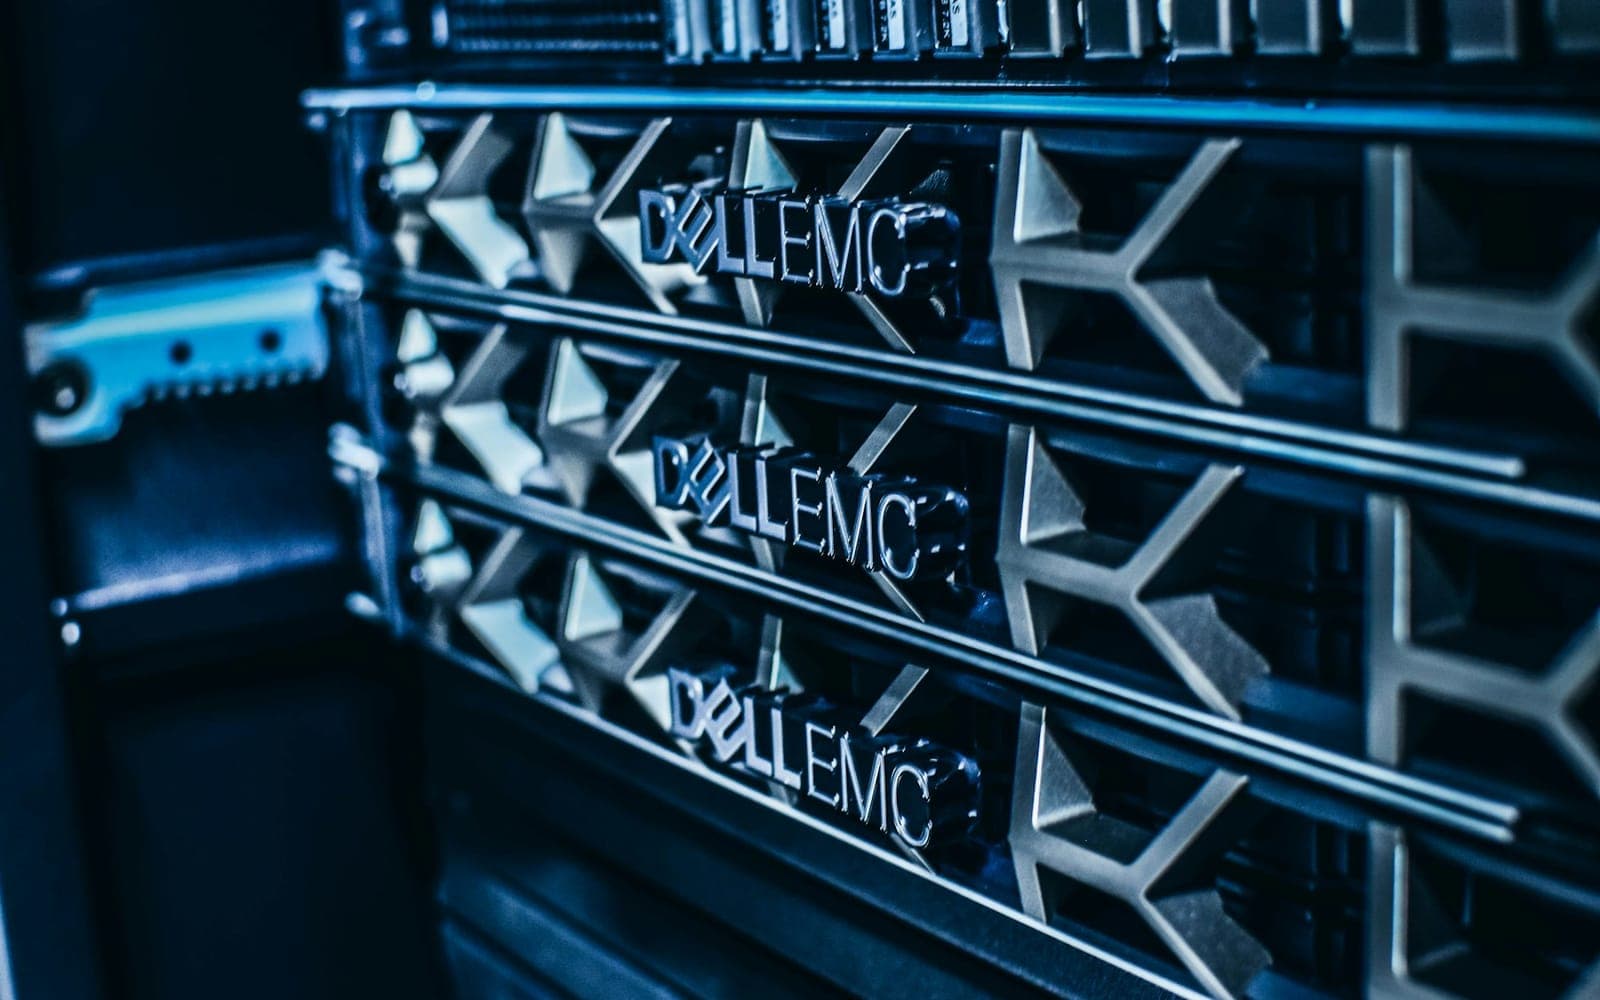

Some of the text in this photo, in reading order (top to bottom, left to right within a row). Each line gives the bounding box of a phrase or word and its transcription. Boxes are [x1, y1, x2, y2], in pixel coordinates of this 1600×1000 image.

[638, 189, 911, 296] DELL EMC
[652, 435, 920, 580] DELL EMC
[668, 667, 933, 848] DELL EMC
